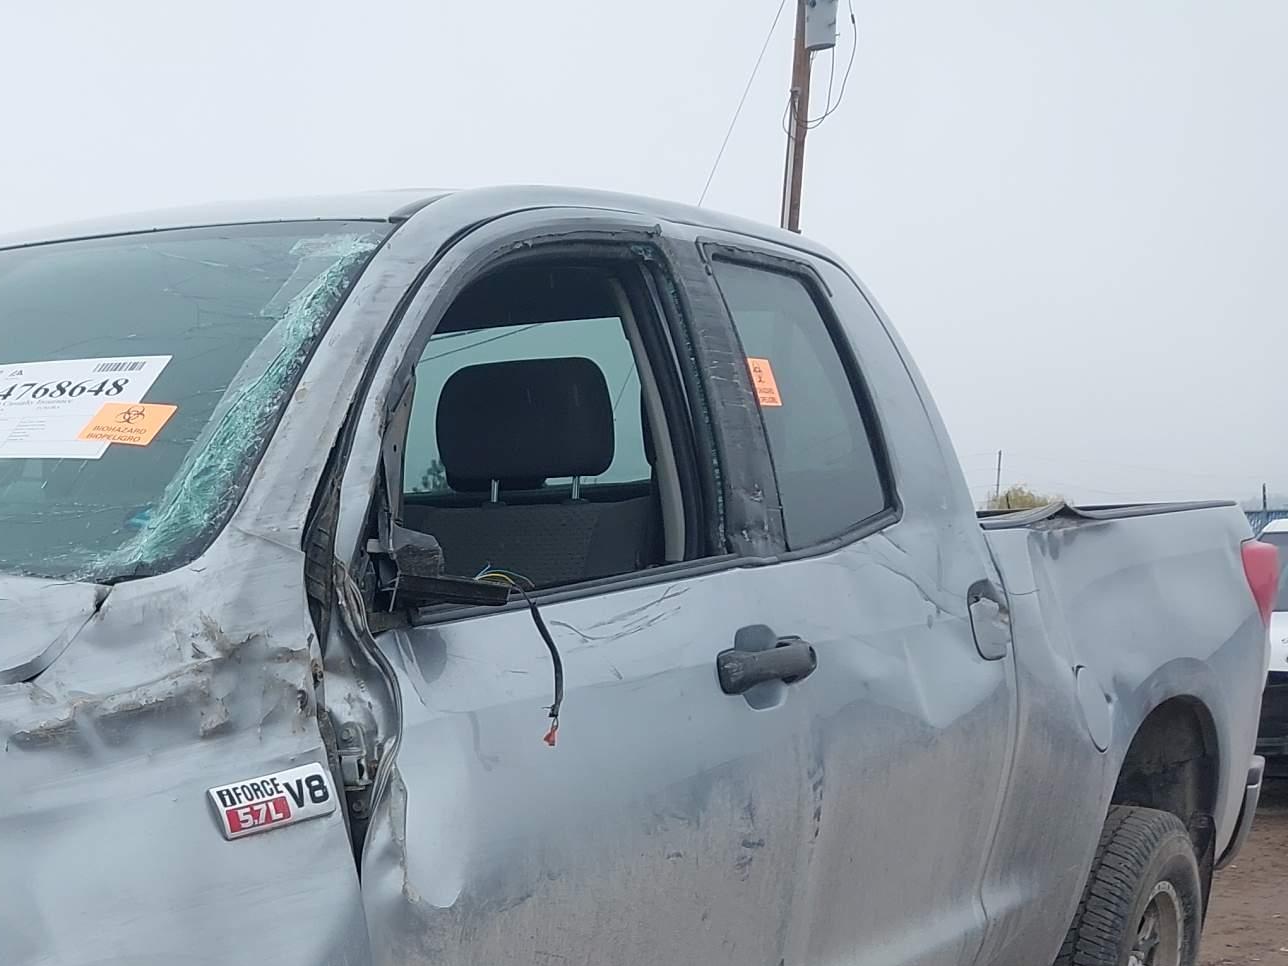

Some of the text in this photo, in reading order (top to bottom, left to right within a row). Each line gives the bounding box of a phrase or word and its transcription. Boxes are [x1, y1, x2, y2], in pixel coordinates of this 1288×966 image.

[85, 432, 142, 443] BIOPELIGRO
[92, 425, 148, 435] BIOHAZARD
[282, 774, 330, 809] V8
[236, 797, 285, 829] 5.7L
